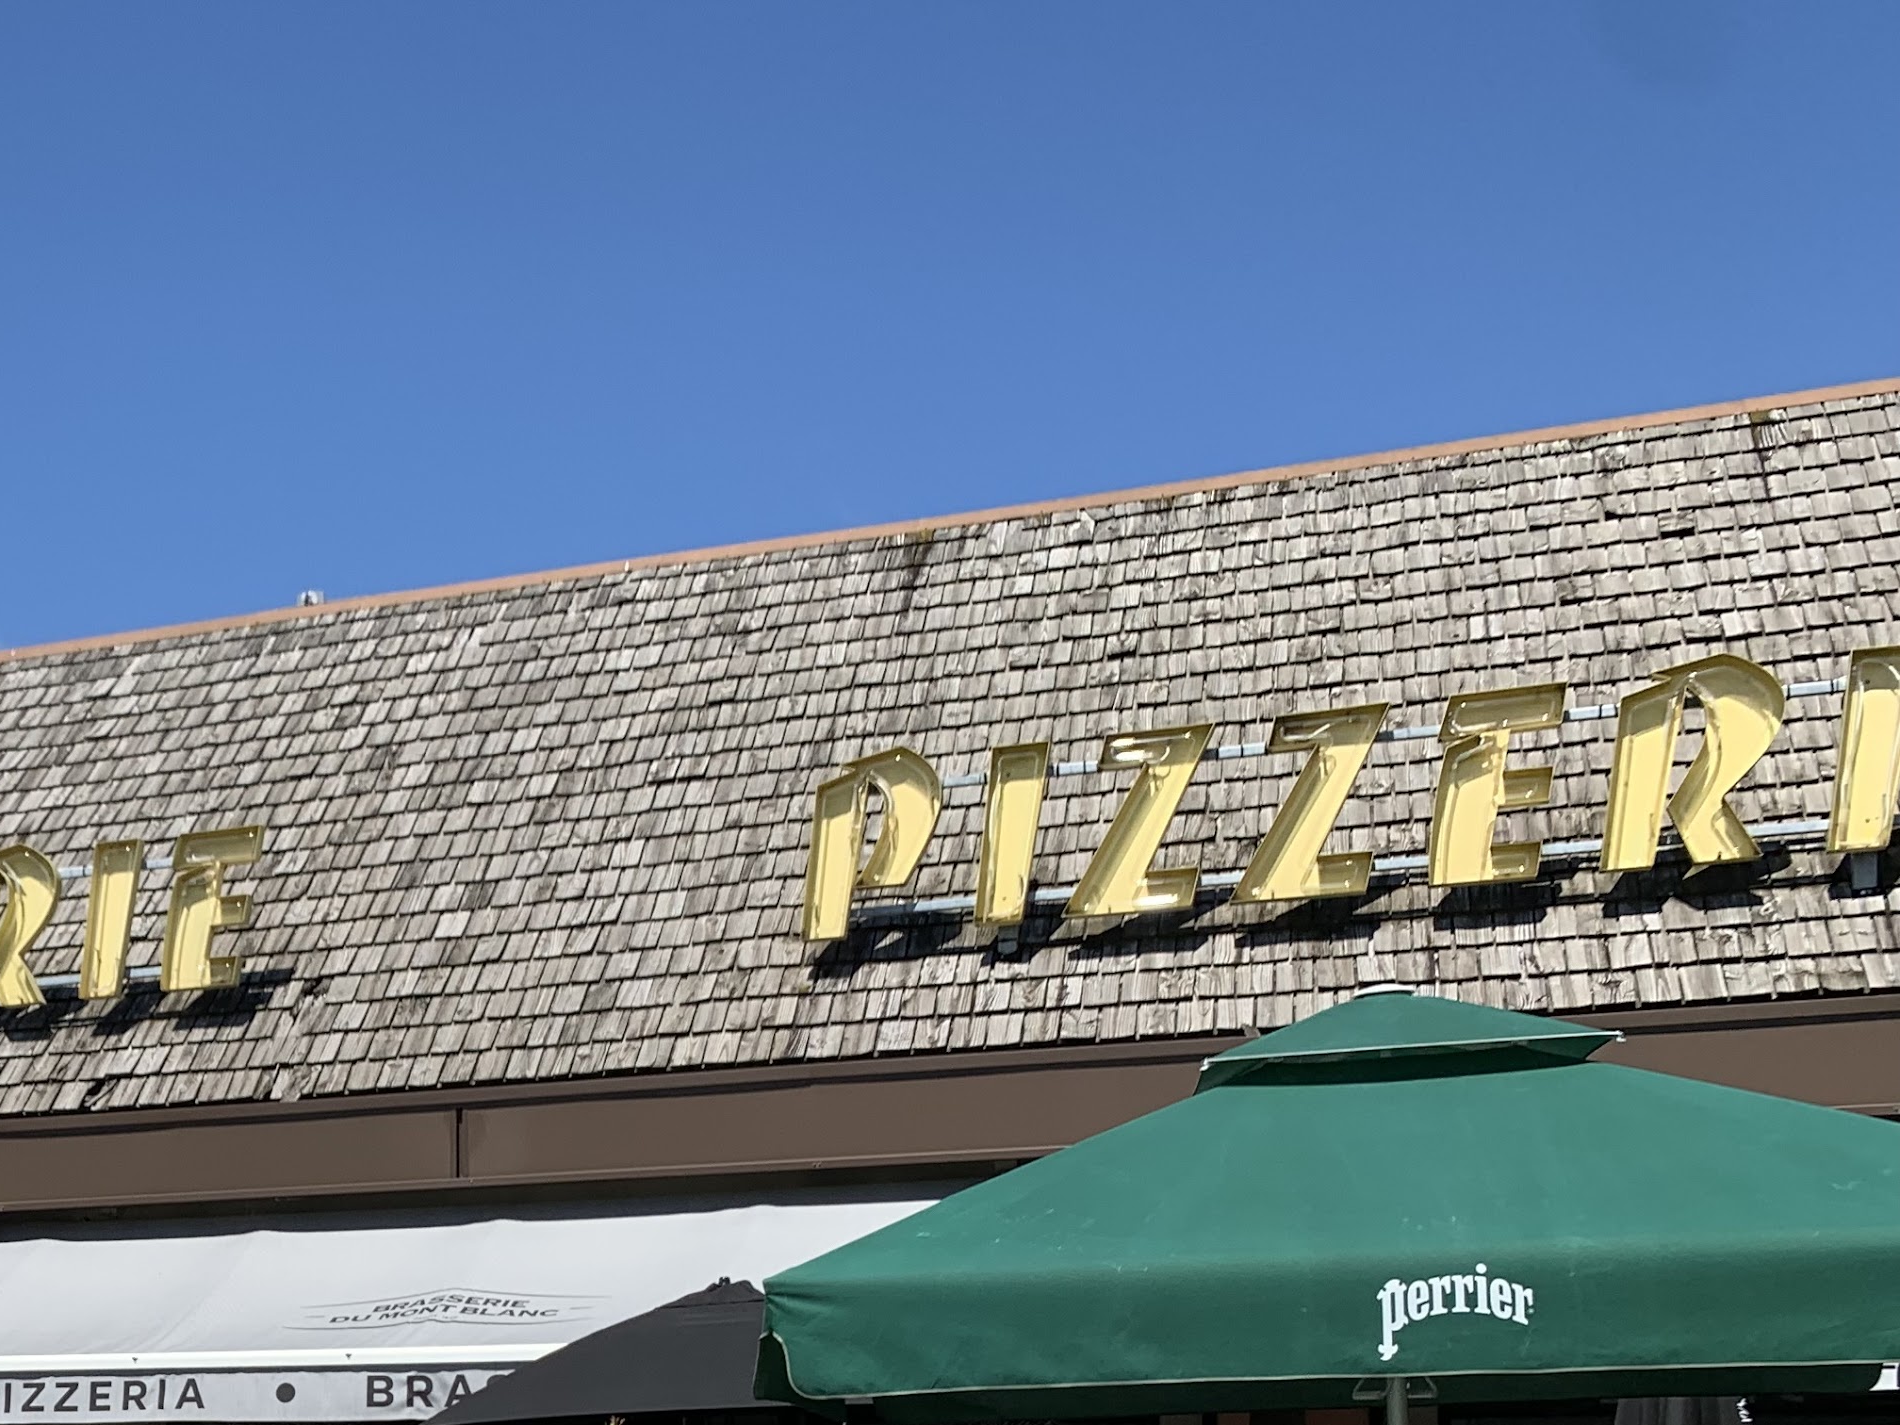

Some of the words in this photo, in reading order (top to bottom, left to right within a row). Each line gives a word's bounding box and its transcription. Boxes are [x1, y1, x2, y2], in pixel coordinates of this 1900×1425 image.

[804, 645, 1900, 942] PIZZERI
[328, 1314, 372, 1324] DU
[378, 1304, 458, 1320] MONT
[460, 1305, 560, 1318] BLANC
[372, 1293, 531, 1313] BRASSERIE
[365, 1374, 504, 1408] BRA
